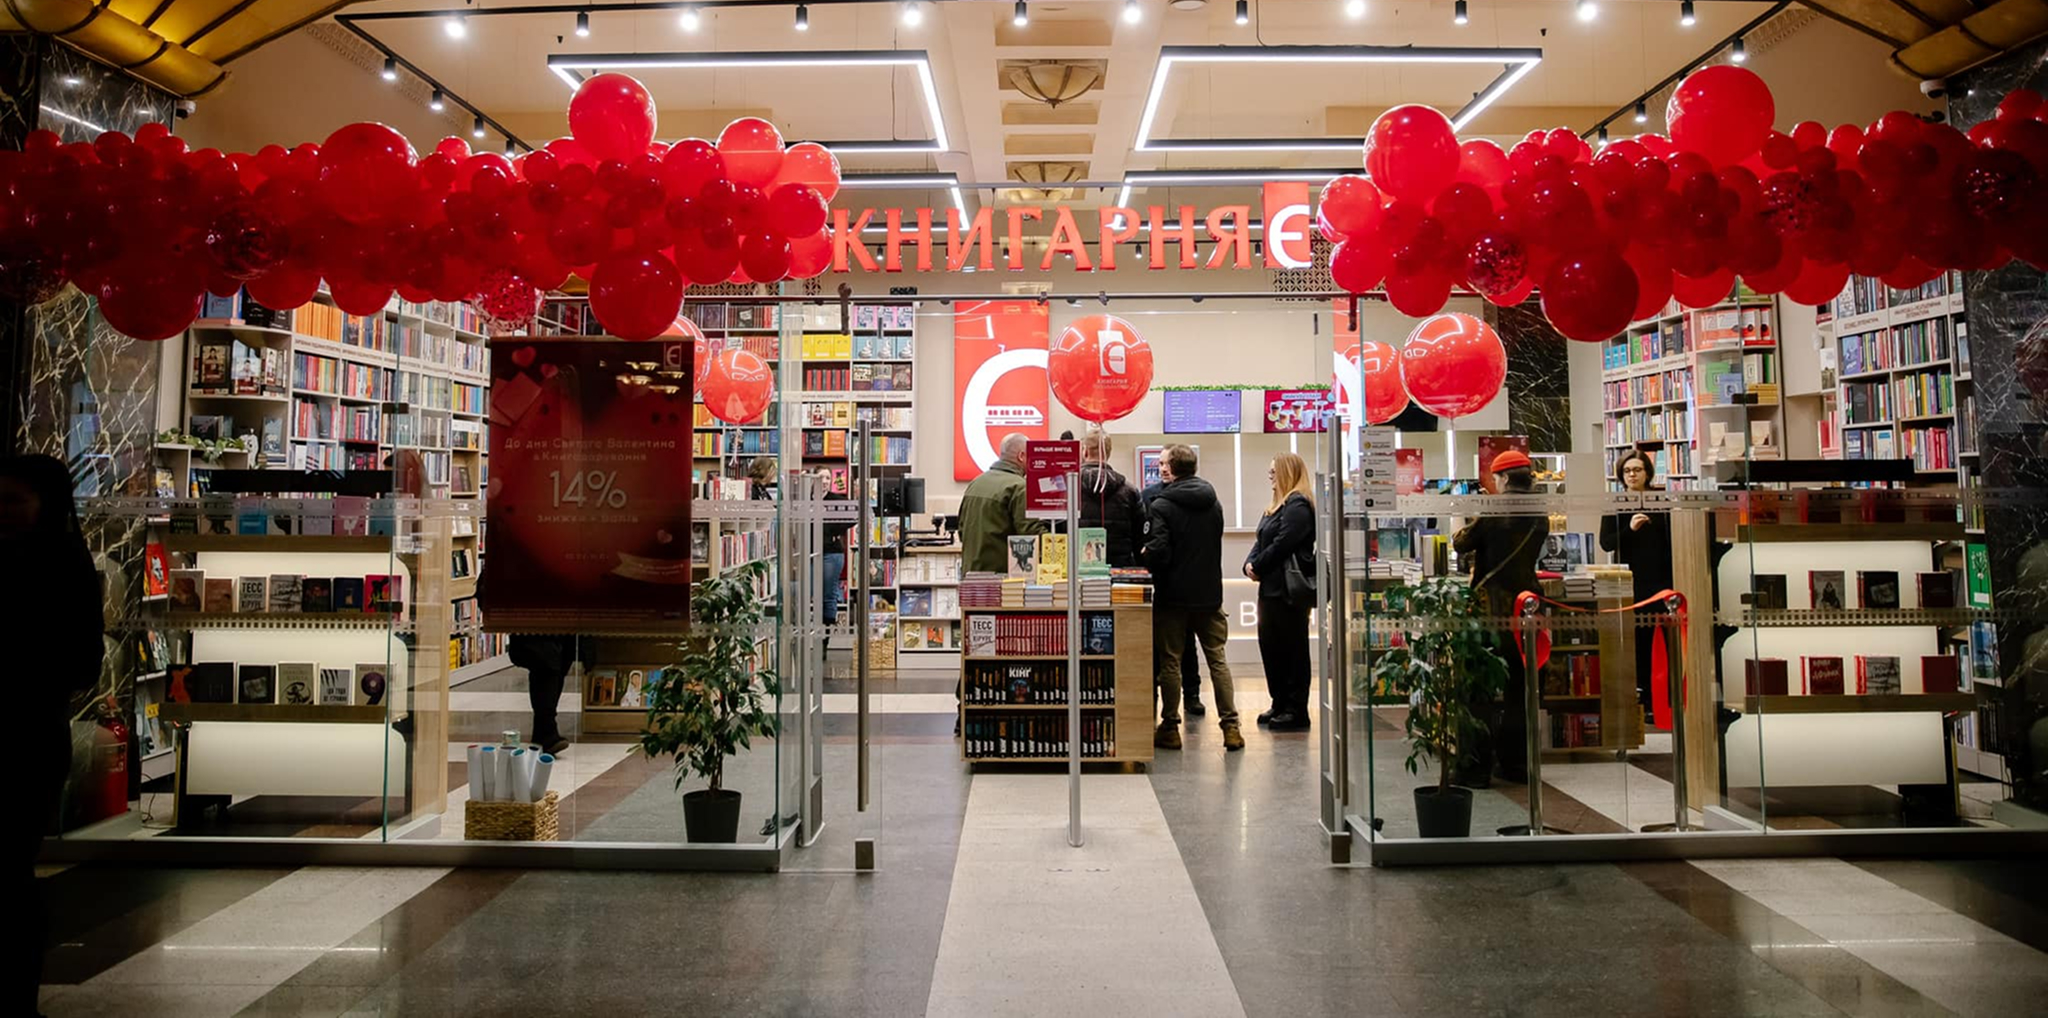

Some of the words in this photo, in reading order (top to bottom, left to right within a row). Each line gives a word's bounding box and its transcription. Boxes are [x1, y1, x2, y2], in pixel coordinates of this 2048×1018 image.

[832, 205, 1252, 272] КНИГАРНЯ
[1269, 203, 1312, 269] Є
[504, 437, 521, 450] До
[526, 440, 548, 450] дня
[607, 437, 676, 449] Валентина
[550, 470, 627, 508] 14%
[242, 582, 263, 593] ТЕСС
[973, 621, 992, 630] ТЕСС
[1092, 618, 1112, 628] ТЕСС
